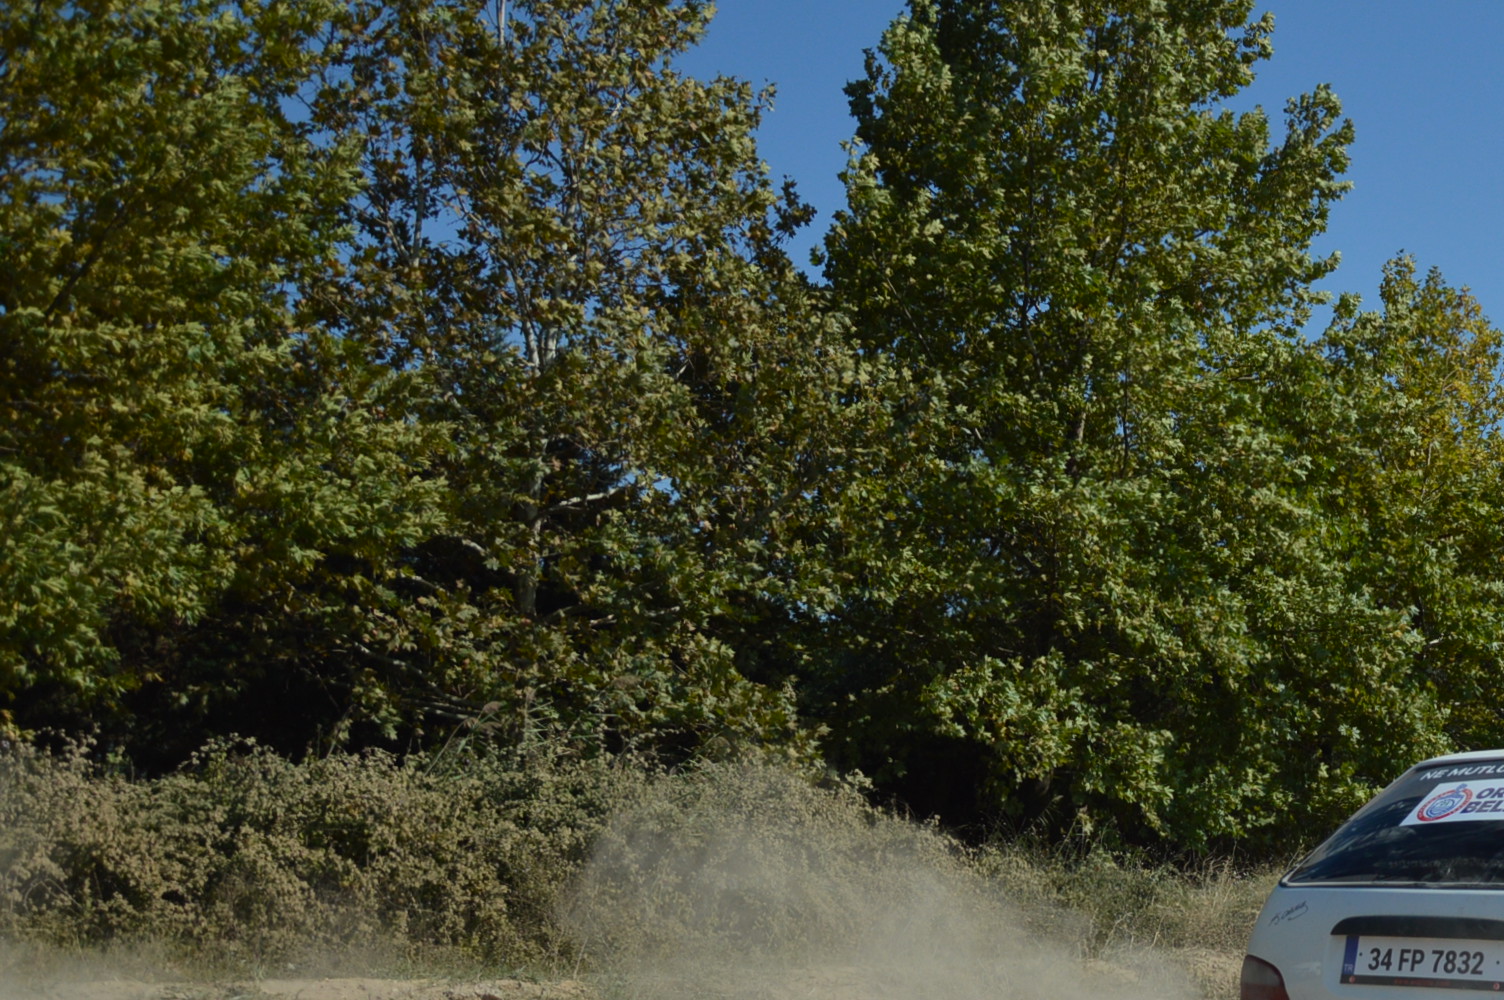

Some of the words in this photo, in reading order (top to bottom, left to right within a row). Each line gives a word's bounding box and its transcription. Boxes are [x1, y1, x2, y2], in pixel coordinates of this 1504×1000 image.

[1420, 769, 1448, 780] NE
[1368, 947, 1393, 971] 34
[1398, 948, 1425, 972] FP
[1431, 950, 1484, 975] 7832
